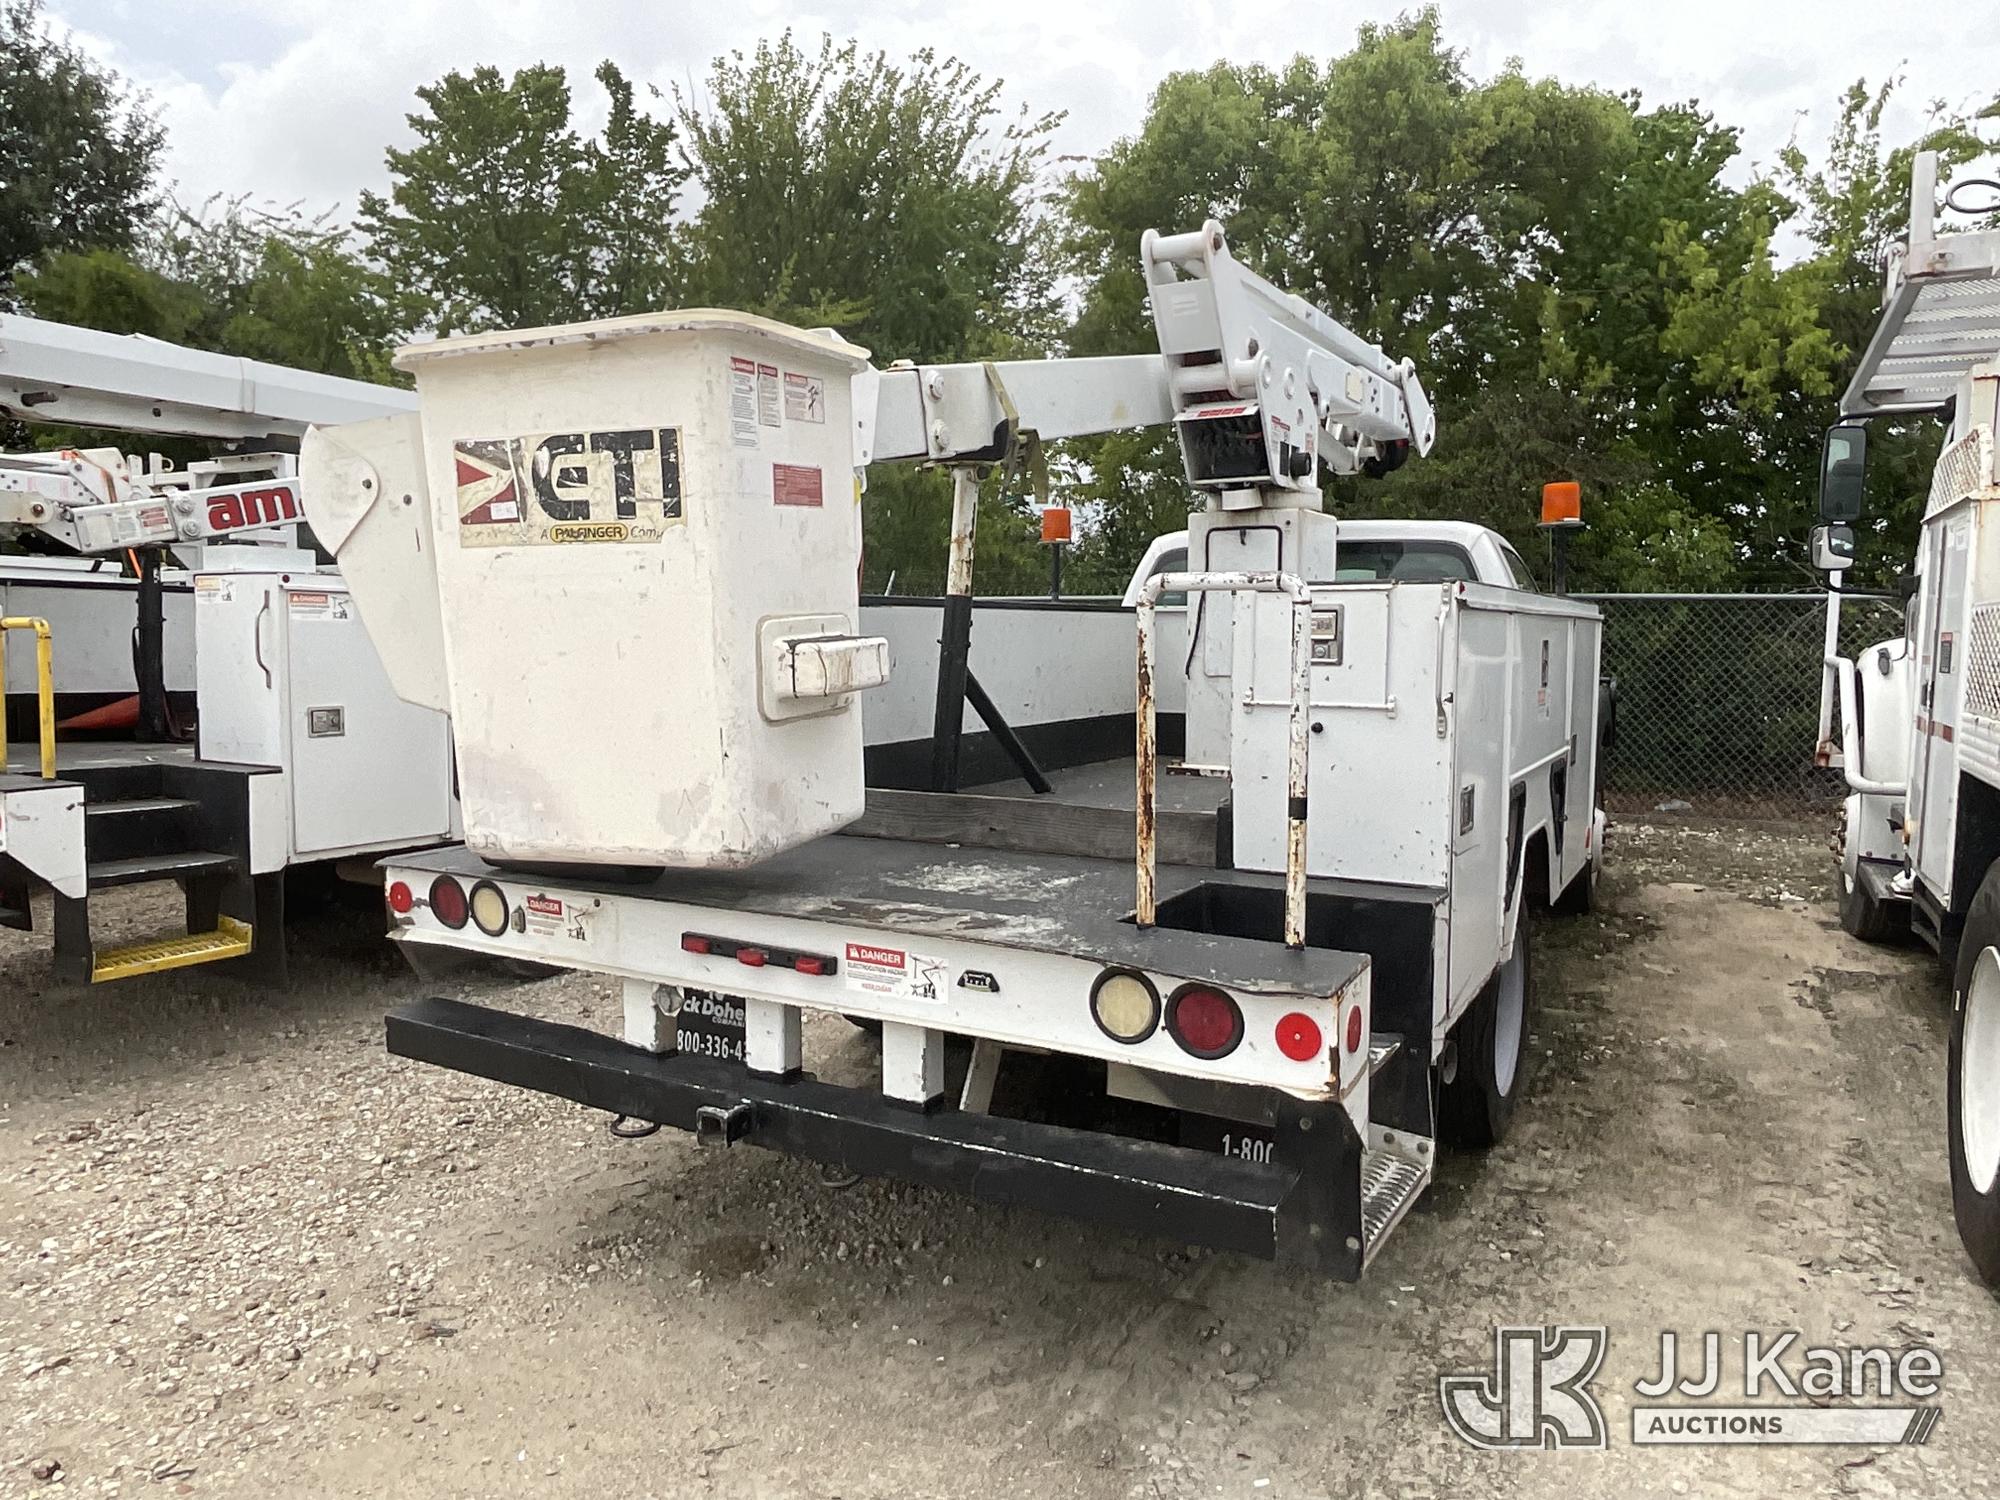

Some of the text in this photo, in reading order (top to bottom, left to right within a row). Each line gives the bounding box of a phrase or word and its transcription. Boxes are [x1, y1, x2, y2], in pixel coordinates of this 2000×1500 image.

[532, 428, 682, 521] ETI
[206, 487, 299, 531] am
[630, 525, 663, 540] Comp
[860, 948, 901, 965] DANGER
[682, 995, 701, 1014] ck
[701, 999, 745, 1021] Dohe
[712, 1015, 745, 1028] COMPAN
[676, 1029, 743, 1061] 800-336-4
